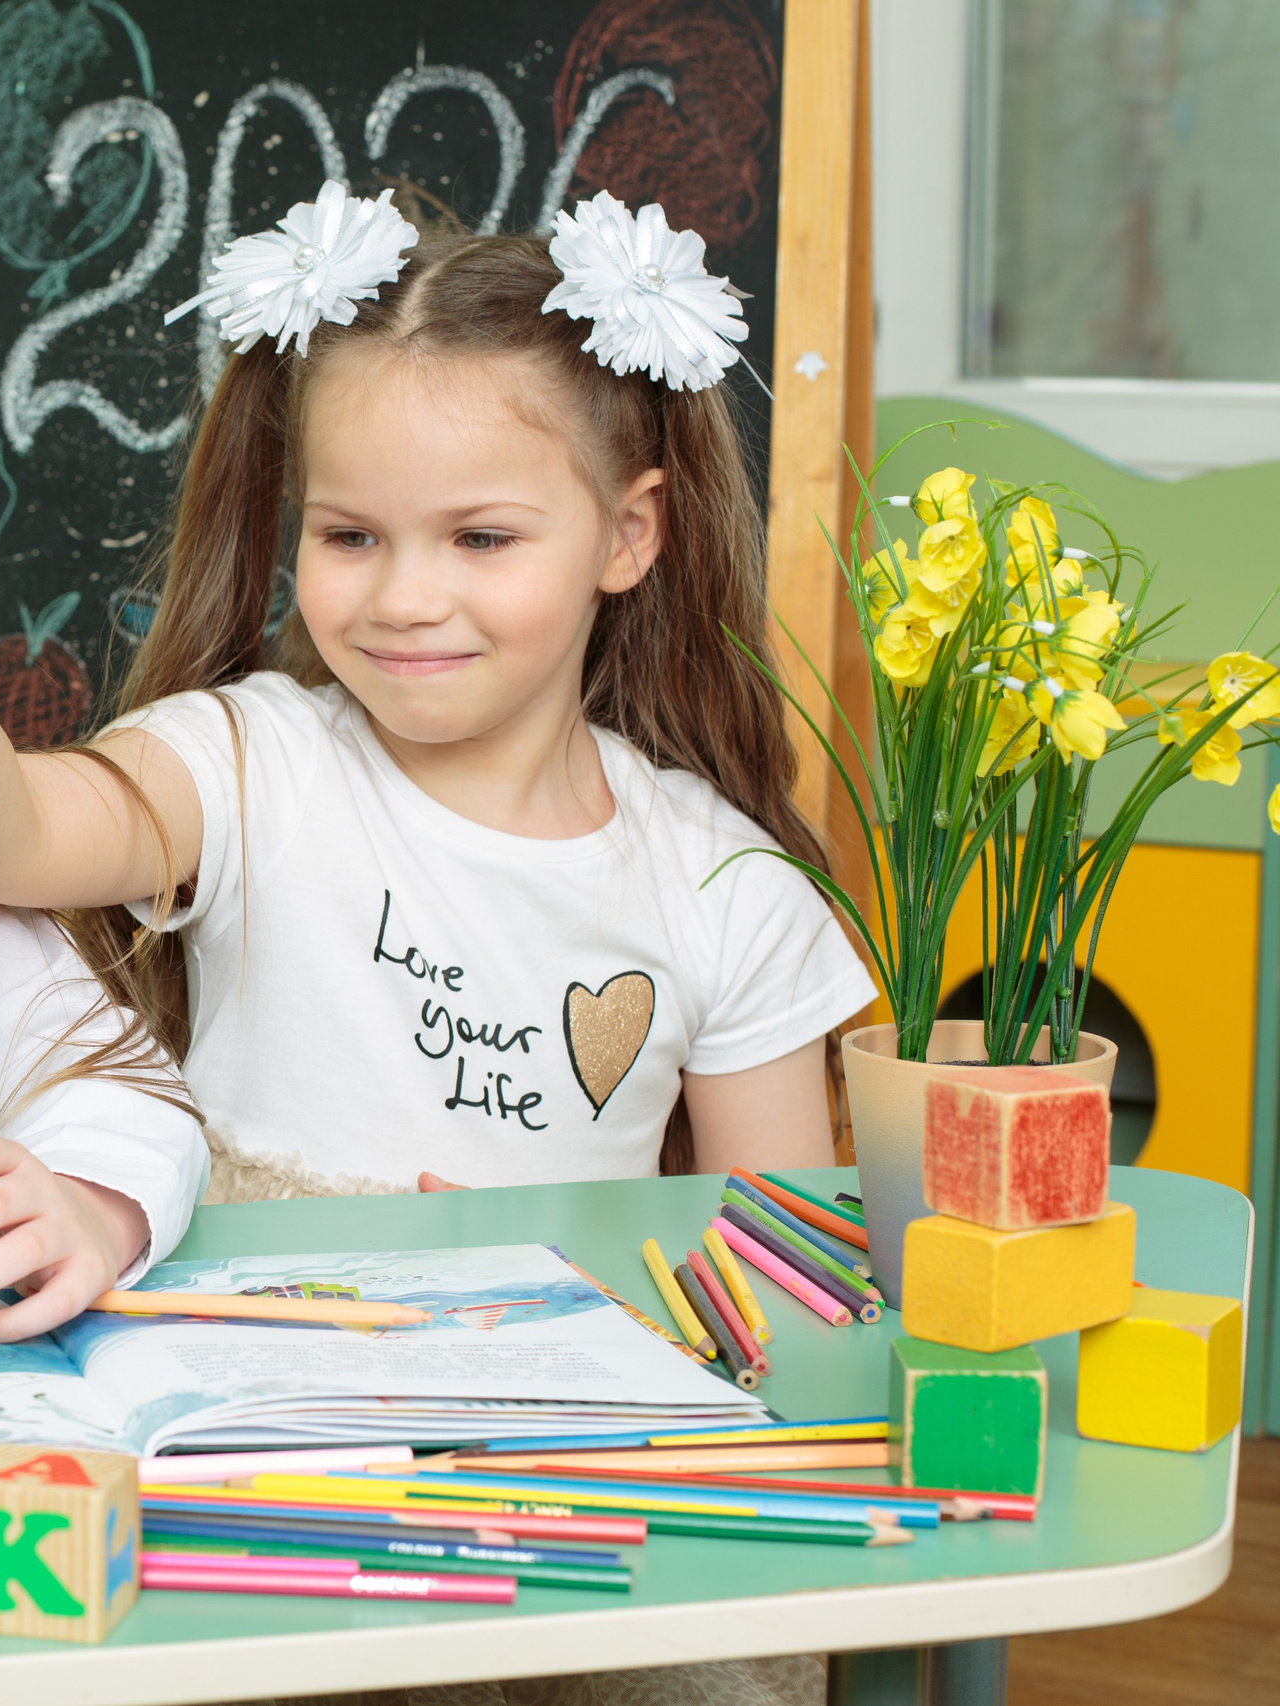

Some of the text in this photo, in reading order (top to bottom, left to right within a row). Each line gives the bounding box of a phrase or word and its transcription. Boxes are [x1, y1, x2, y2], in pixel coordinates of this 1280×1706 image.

[373, 889, 464, 992] Love
[414, 998, 542, 1060] your
[445, 1056, 549, 1131] Life
